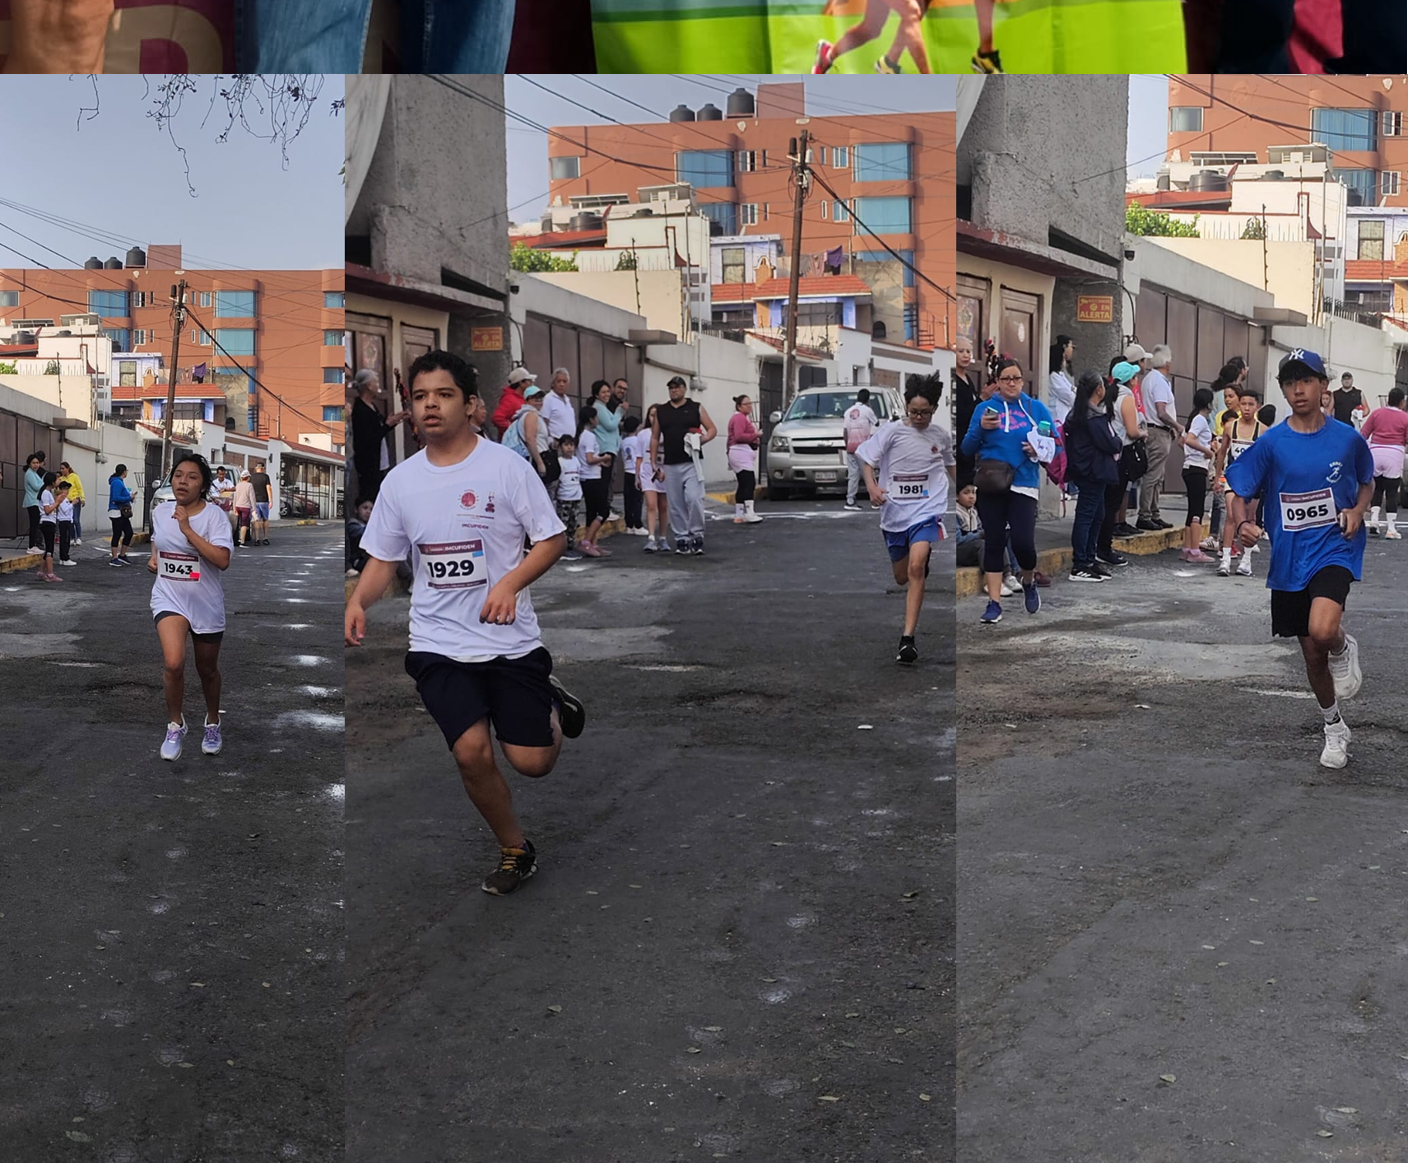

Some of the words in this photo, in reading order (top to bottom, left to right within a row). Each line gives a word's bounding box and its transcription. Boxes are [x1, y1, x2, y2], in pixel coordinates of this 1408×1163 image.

[1079, 311, 1110, 319] ALERTA
[899, 484, 923, 495] 1981
[1286, 504, 1329, 521] 0965
[164, 562, 193, 575] 1943
[427, 559, 475, 579] 1929
